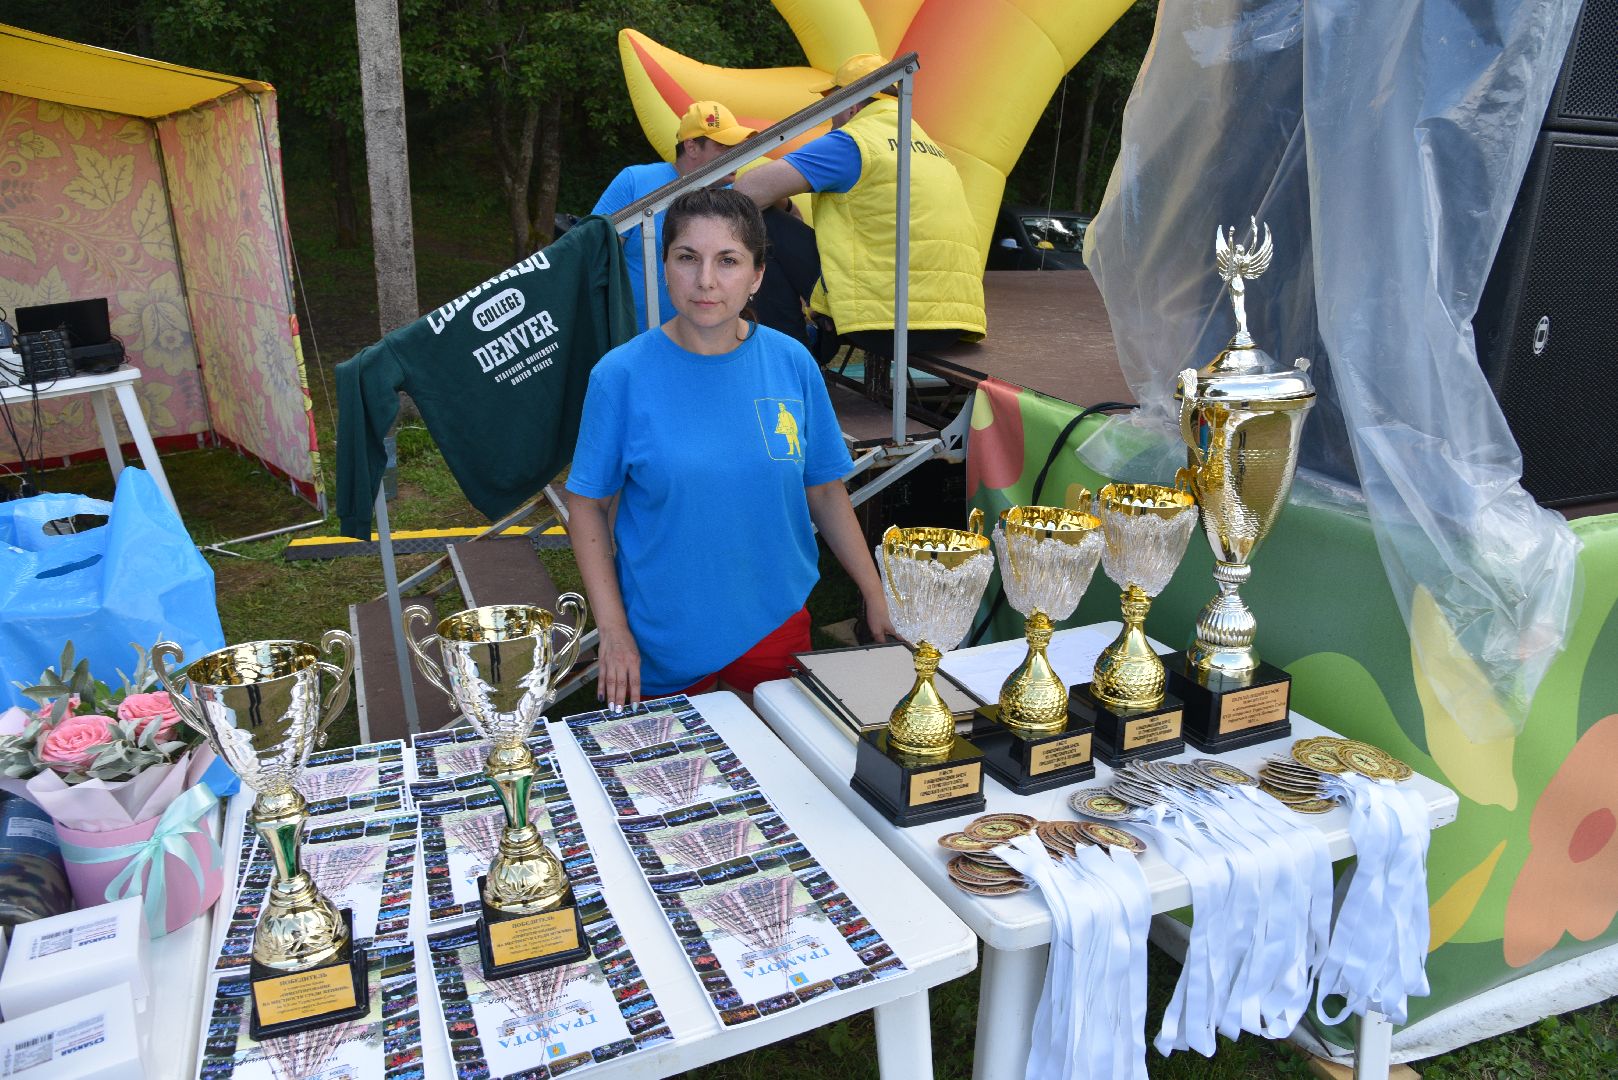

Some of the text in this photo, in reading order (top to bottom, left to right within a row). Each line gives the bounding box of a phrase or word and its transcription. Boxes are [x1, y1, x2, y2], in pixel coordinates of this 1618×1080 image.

[476, 293, 521, 327] COLLEGE
[472, 310, 559, 373] DENVER
[494, 342, 559, 383] STATESIDE UNIVERSITY
[511, 358, 553, 386] UNITED STATES
[512, 916, 555, 929] ПОБЕДИТЕЛЬ
[743, 947, 831, 978] ГРАМОТА
[280, 972, 328, 986] ПОБЕДИТЕЛЬ
[498, 1014, 598, 1049] ГРАМОТА
